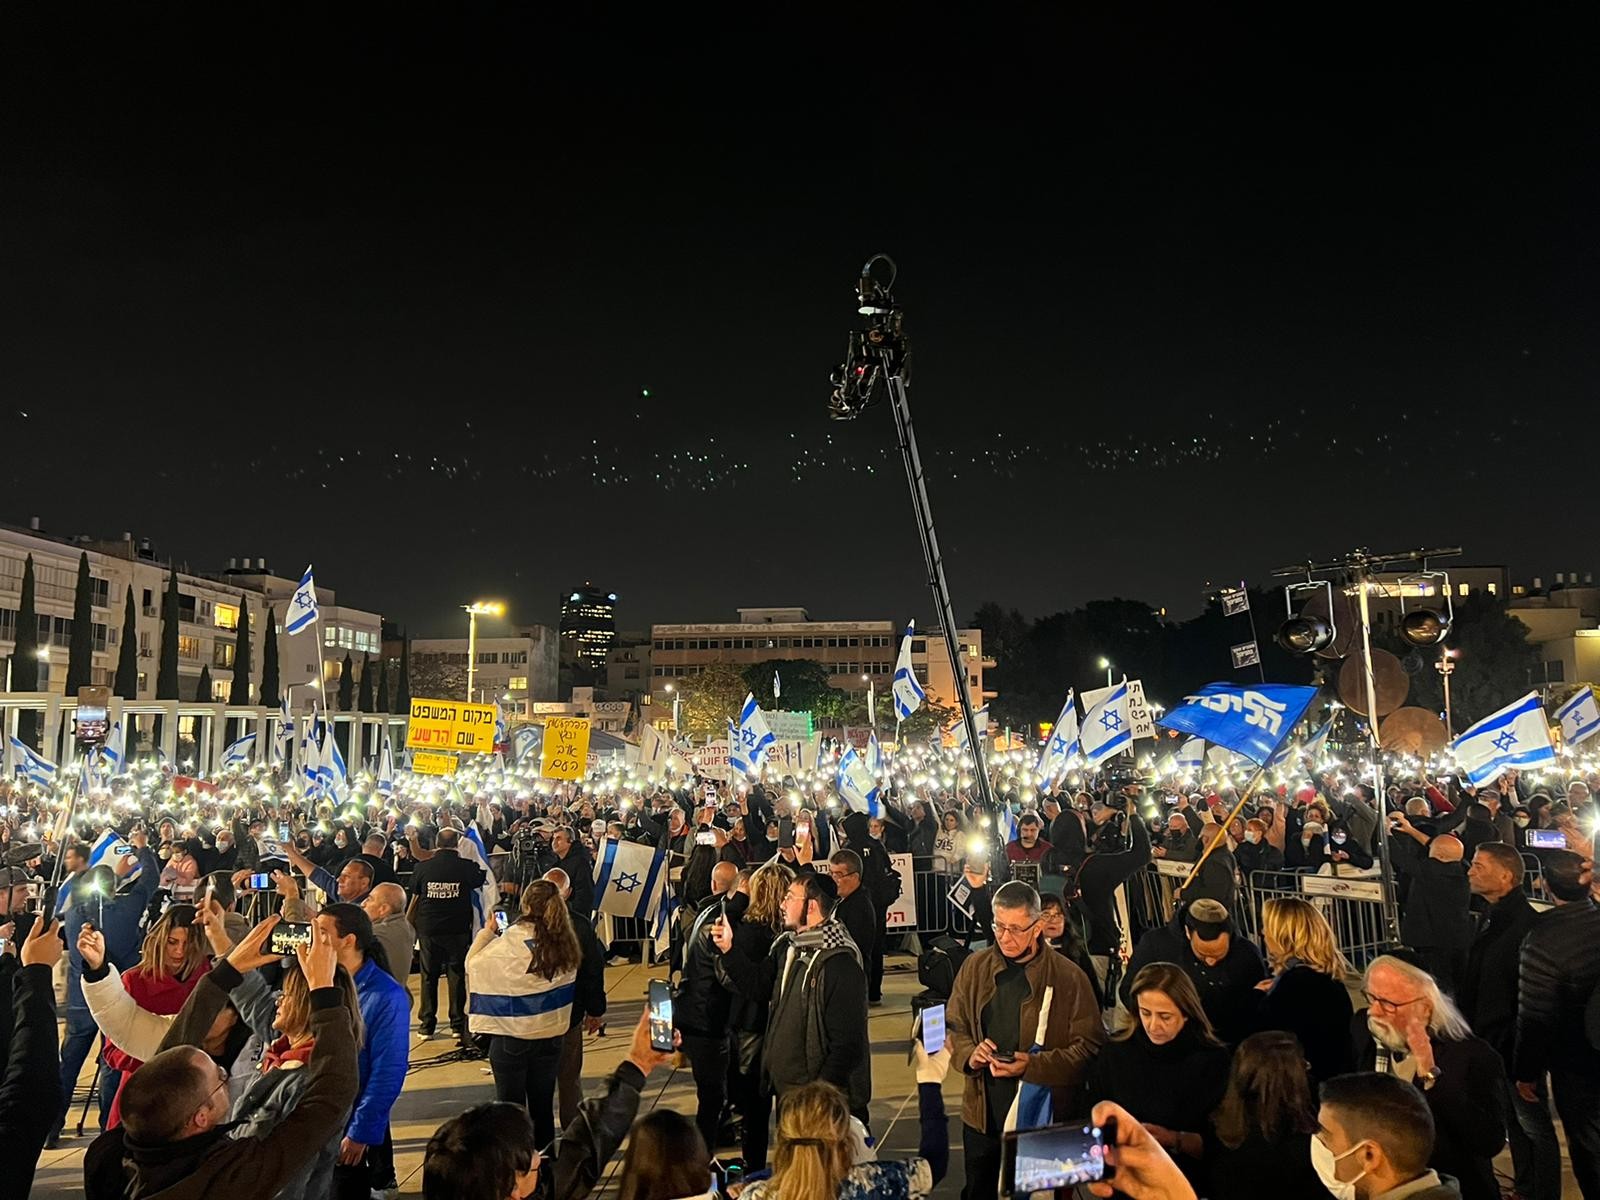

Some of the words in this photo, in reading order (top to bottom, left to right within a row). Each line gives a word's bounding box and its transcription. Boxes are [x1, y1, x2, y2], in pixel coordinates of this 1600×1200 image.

[412, 705, 457, 720] המשפט
[1183, 691, 1286, 736] הליכוד
[456, 731, 475, 745] שם
[698, 746, 728, 755] הודית
[548, 759, 579, 772] העם
[698, 756, 720, 765] JUIF
[427, 881, 460, 891] SECURITY
[427, 890, 459, 899] אבטחה
